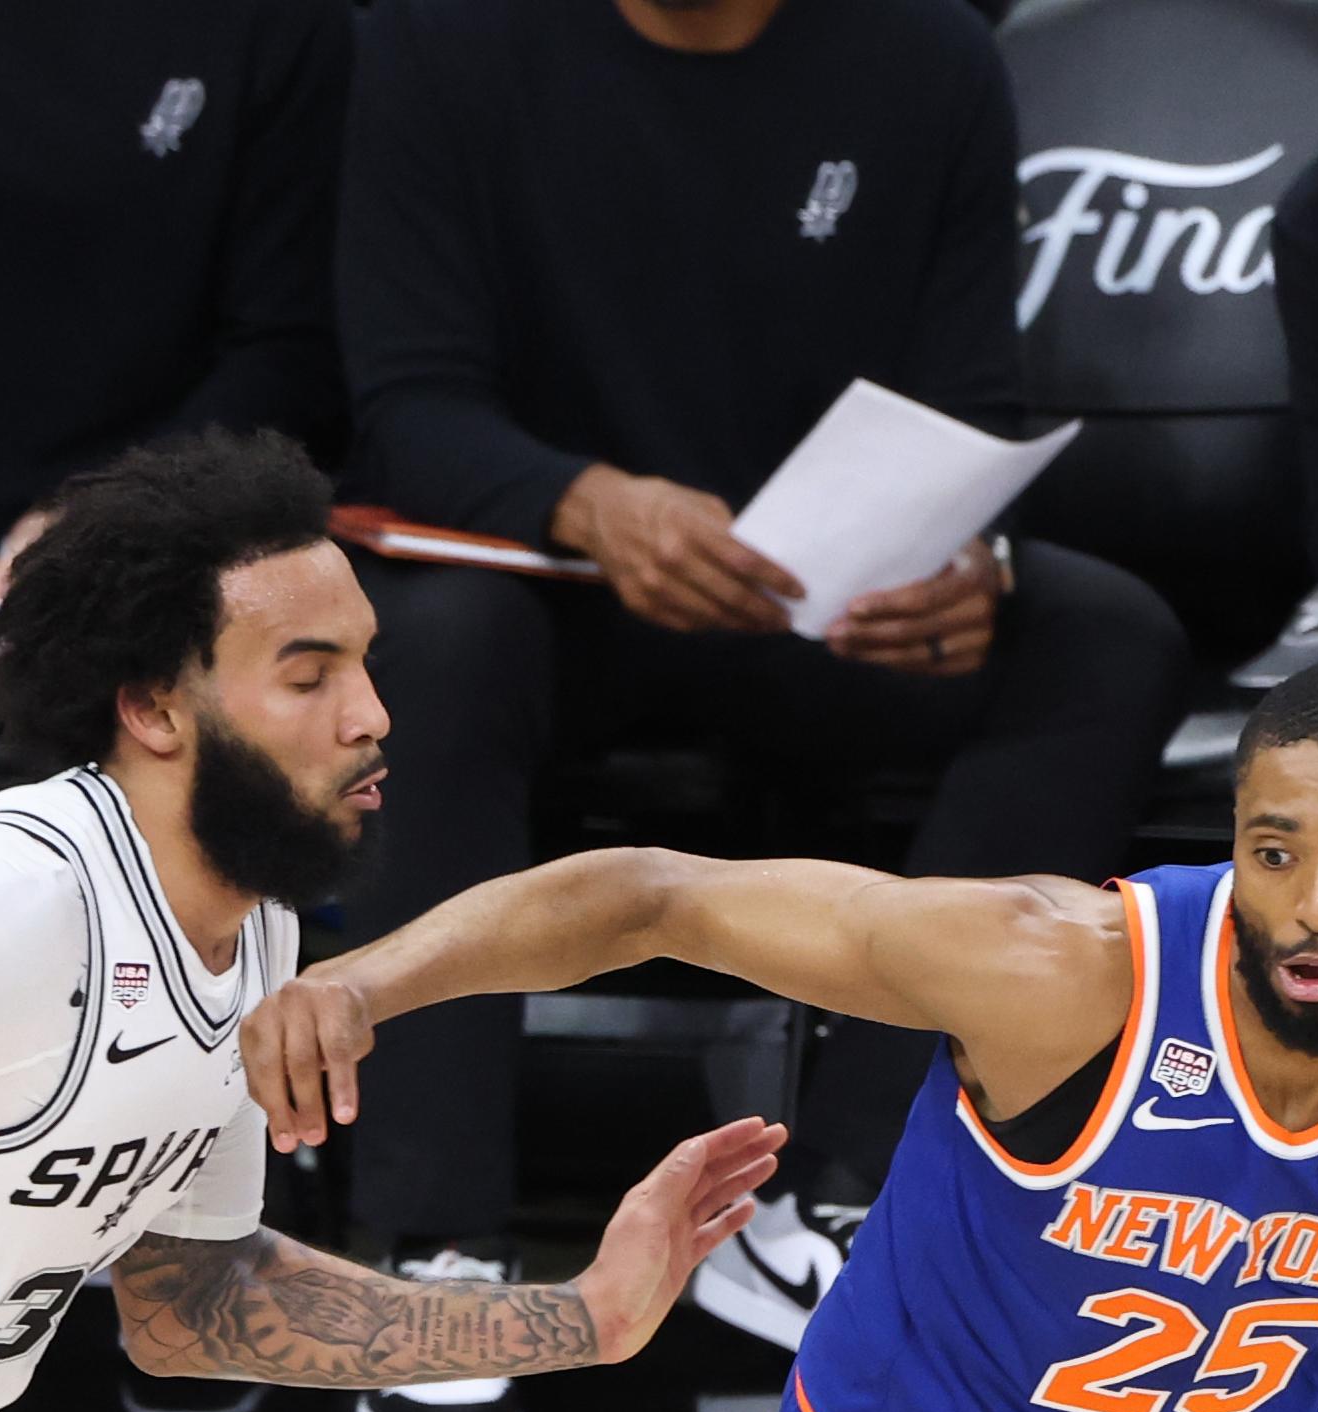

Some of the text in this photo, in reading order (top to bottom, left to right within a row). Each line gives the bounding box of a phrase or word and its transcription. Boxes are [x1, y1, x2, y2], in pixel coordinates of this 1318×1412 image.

[115, 965, 148, 979] USA
[1166, 1046, 1208, 1070] USA
[1157, 1065, 1205, 1092] 250
[1040, 1181, 1251, 1286] NEW
